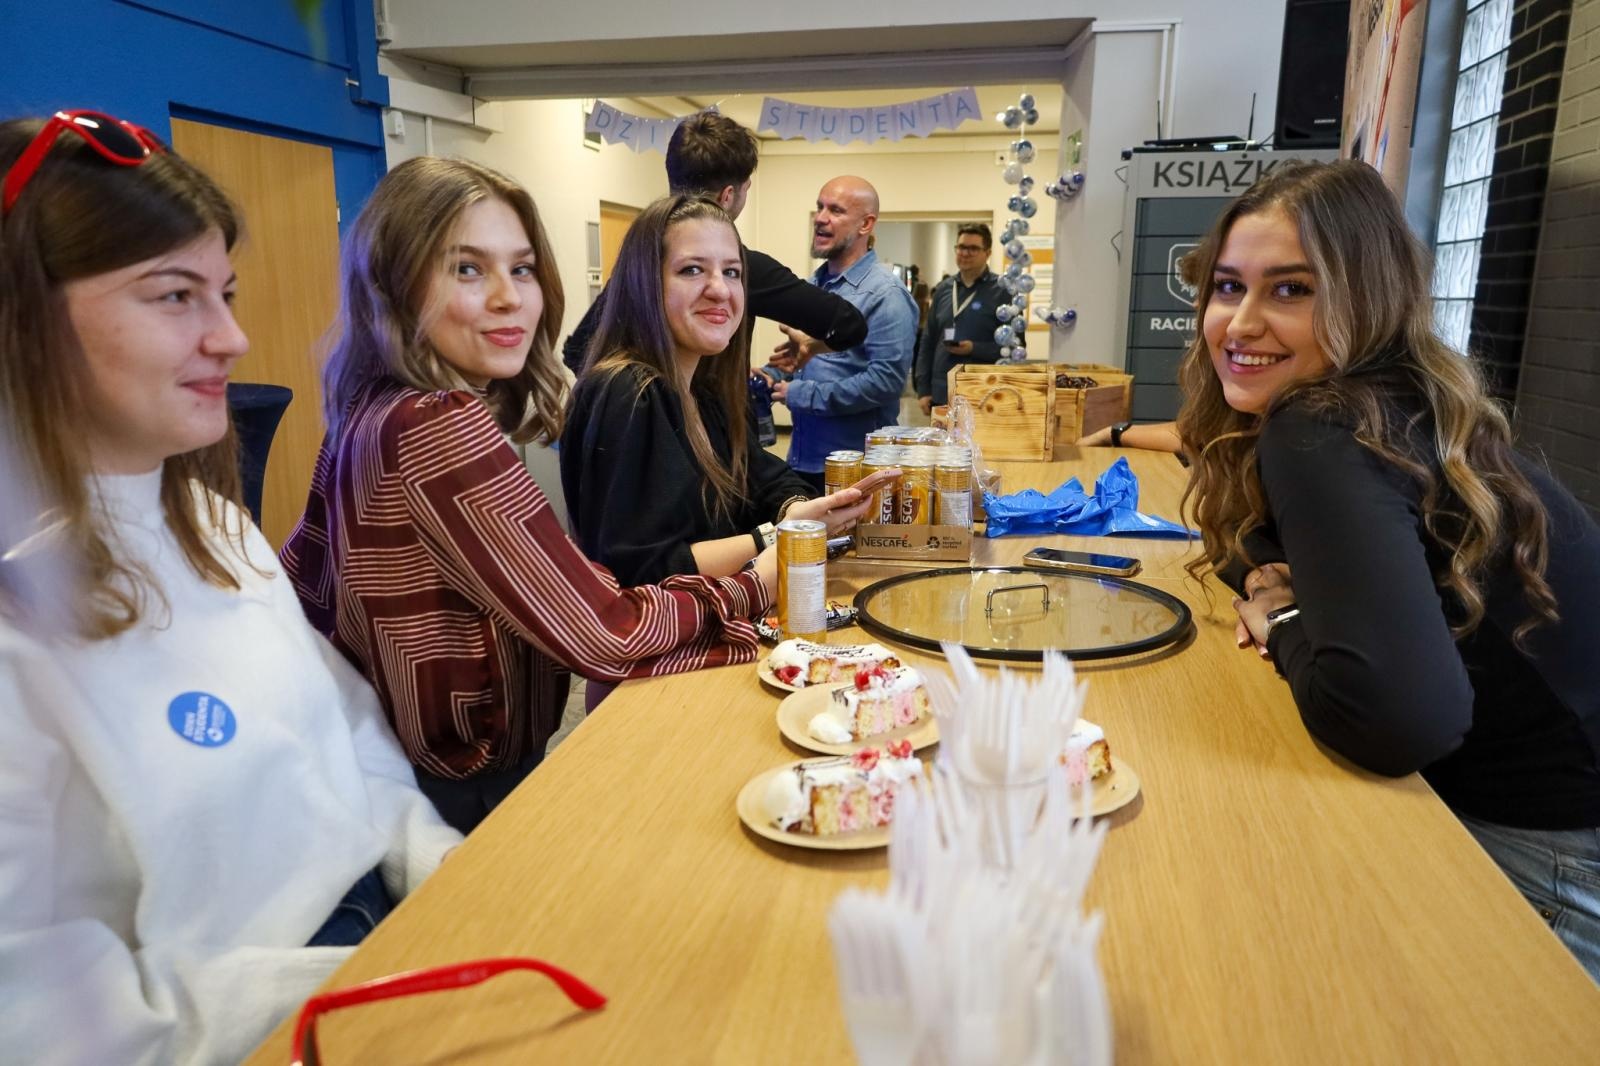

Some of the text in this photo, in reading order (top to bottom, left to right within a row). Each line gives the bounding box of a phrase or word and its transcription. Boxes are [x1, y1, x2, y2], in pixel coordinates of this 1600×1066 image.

[594, 96, 972, 145] DZI STUDENTA
[1152, 154, 1280, 193] KSIĄŻK
